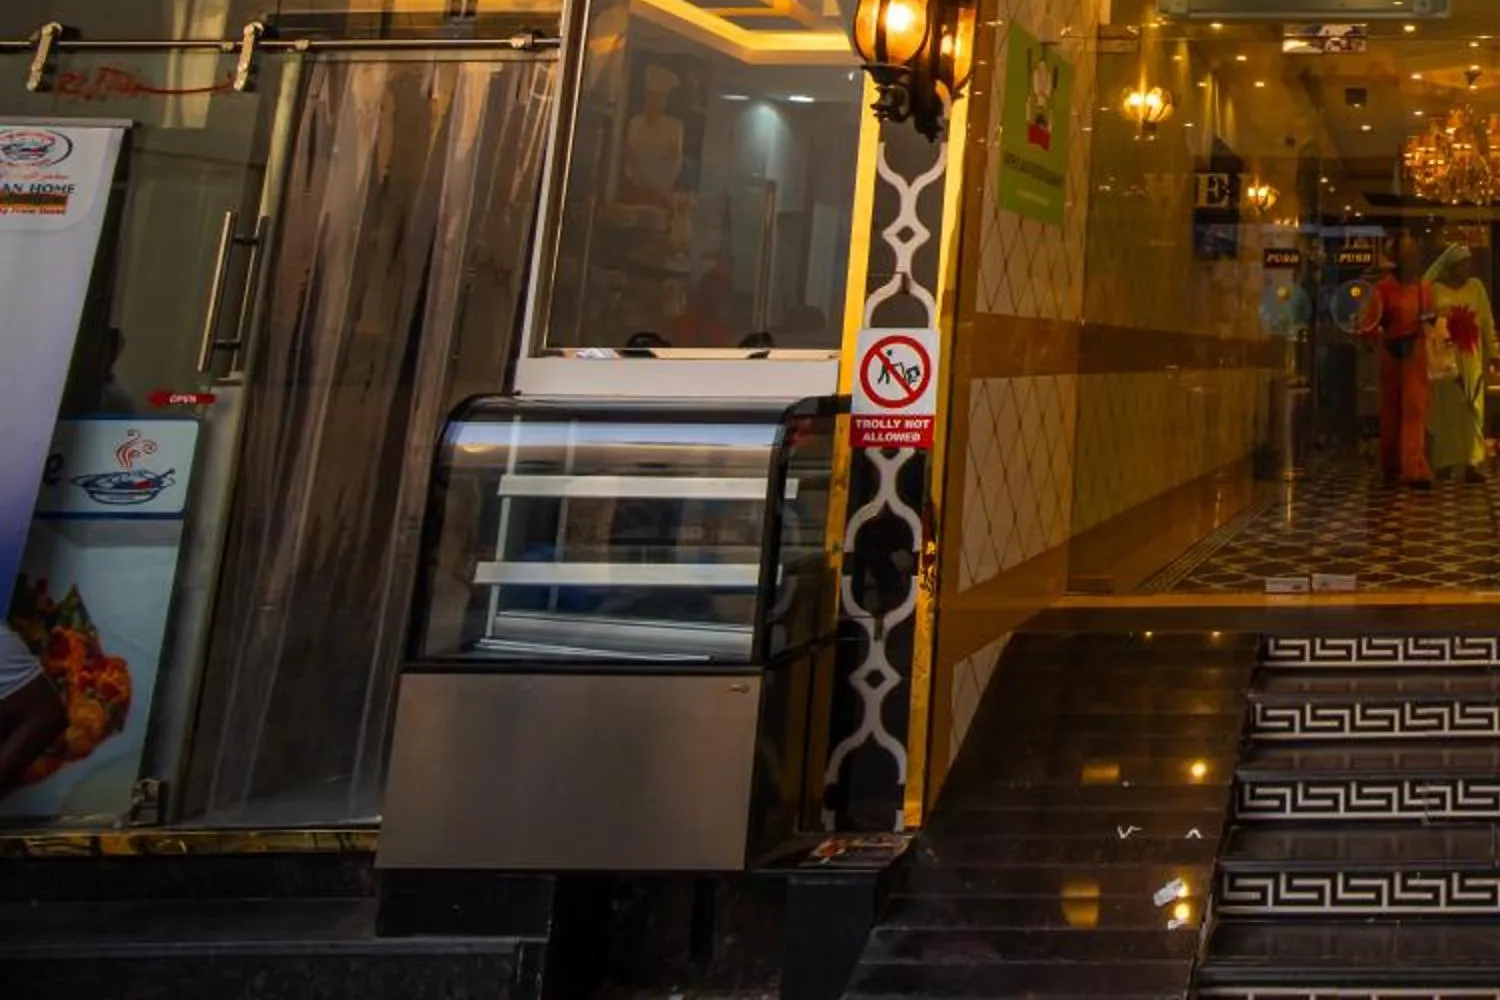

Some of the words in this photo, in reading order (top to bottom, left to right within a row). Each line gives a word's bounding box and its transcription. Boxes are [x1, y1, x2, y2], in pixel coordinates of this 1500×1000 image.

[169, 394, 197, 404] OPEN
[856, 418, 901, 429] TROLLY
[905, 418, 931, 429] NOT
[863, 431, 921, 442] ALLOWED
